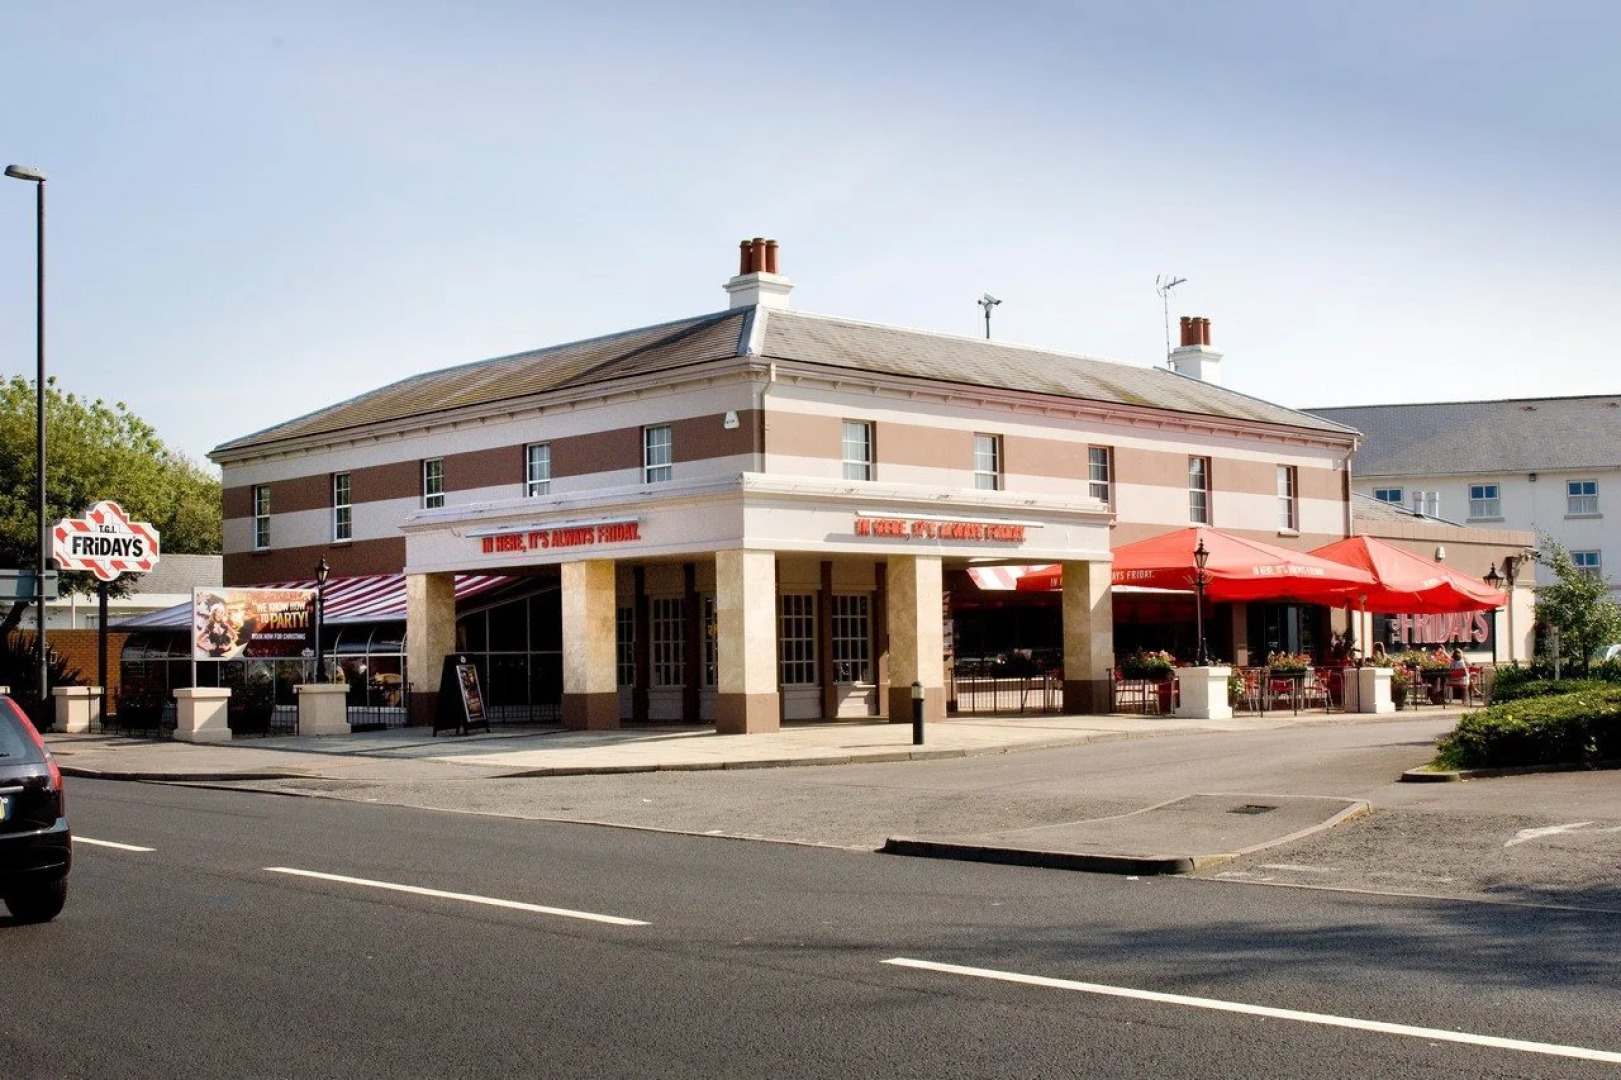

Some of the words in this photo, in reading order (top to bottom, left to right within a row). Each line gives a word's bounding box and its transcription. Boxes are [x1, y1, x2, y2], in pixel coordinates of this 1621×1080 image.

[482, 536, 494, 553] IN
[495, 533, 527, 552] HERE,
[528, 531, 549, 549] IT'S
[551, 527, 594, 547] ALWAYS
[597, 521, 641, 543] FRIDAY.
[938, 522, 984, 542] ALWAYS
[269, 602, 289, 613] KNOW
[260, 614, 269, 623] TO
